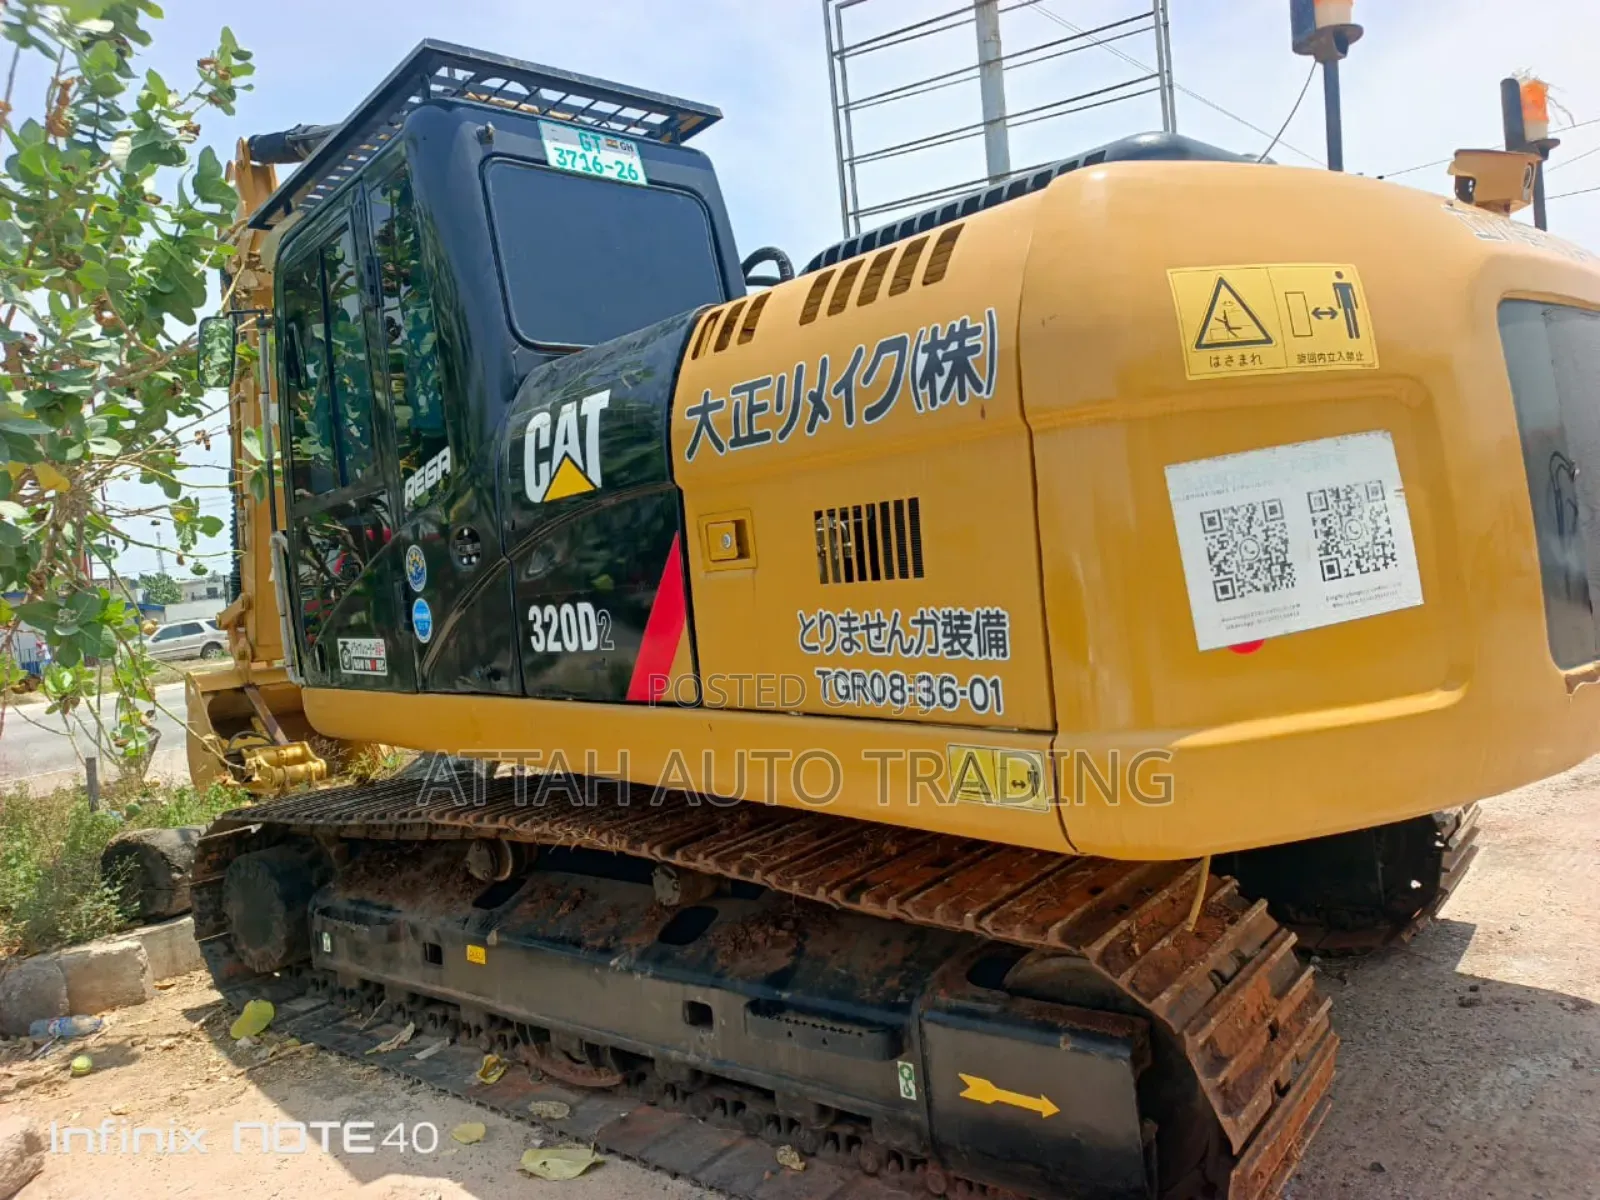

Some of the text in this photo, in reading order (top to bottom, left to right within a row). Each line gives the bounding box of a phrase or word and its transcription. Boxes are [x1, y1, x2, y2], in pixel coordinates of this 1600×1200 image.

[578, 131, 635, 154] GT GH
[553, 147, 639, 181] 3716-26
[1209, 353, 1264, 368] はさまれ
[685, 307, 997, 462] 大正リメイク(株)
[524, 389, 611, 503] CAT
[814, 666, 1005, 716] TGR08-36-01
